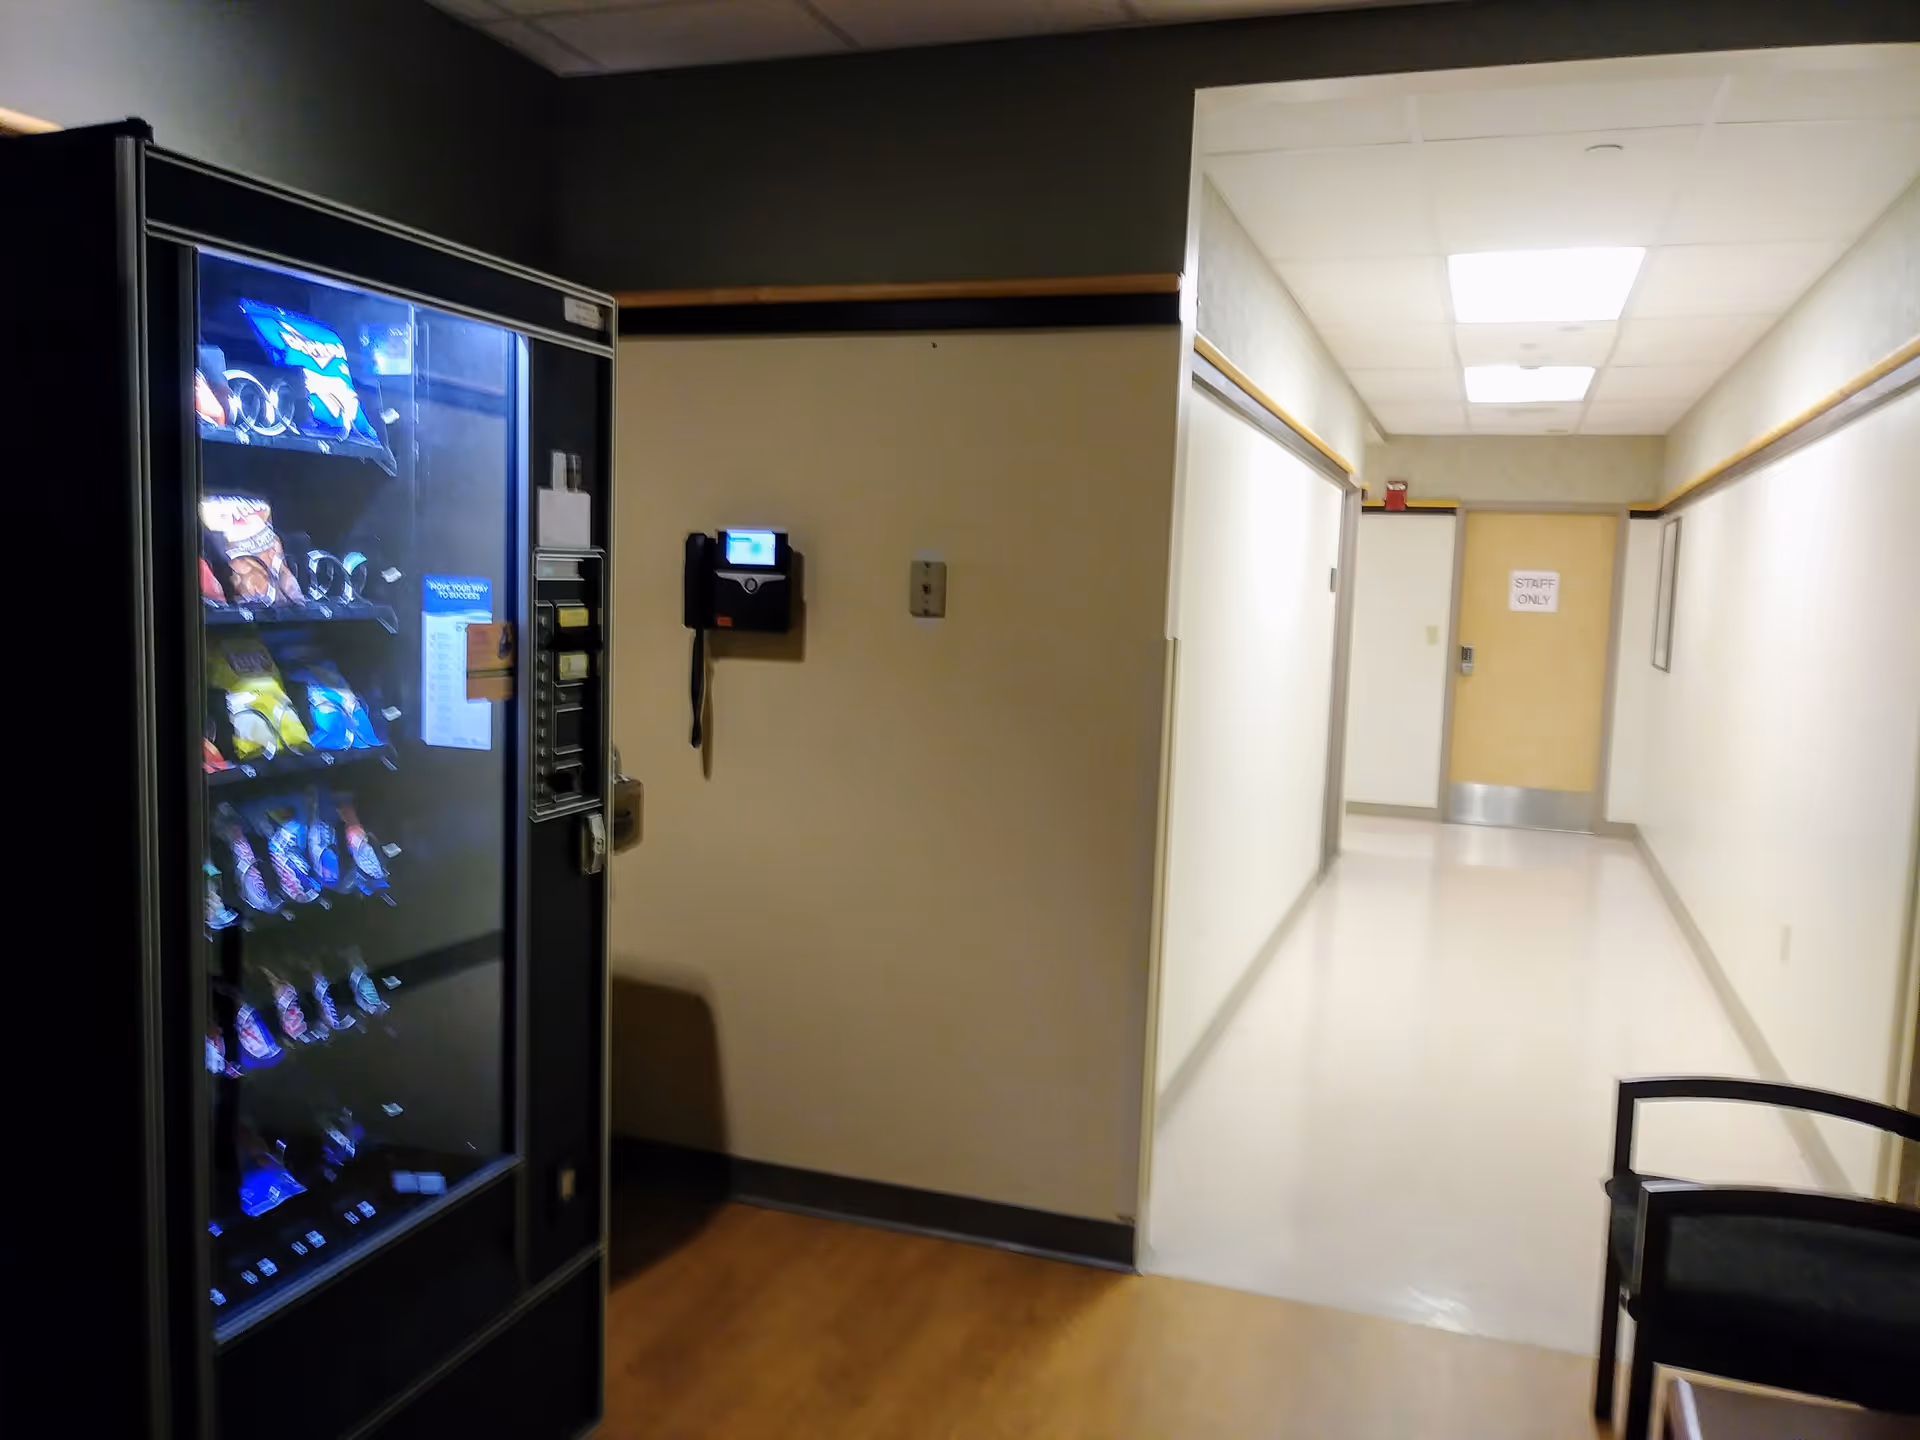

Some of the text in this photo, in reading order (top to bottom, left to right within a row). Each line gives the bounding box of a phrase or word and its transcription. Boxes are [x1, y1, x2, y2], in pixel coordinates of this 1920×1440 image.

[429, 582, 488, 593] MOVE YOUR WAY
[1514, 578, 1556, 588] STAFF
[440, 591, 480, 600] TO SUCCESS
[1518, 594, 1551, 605] ONLY
